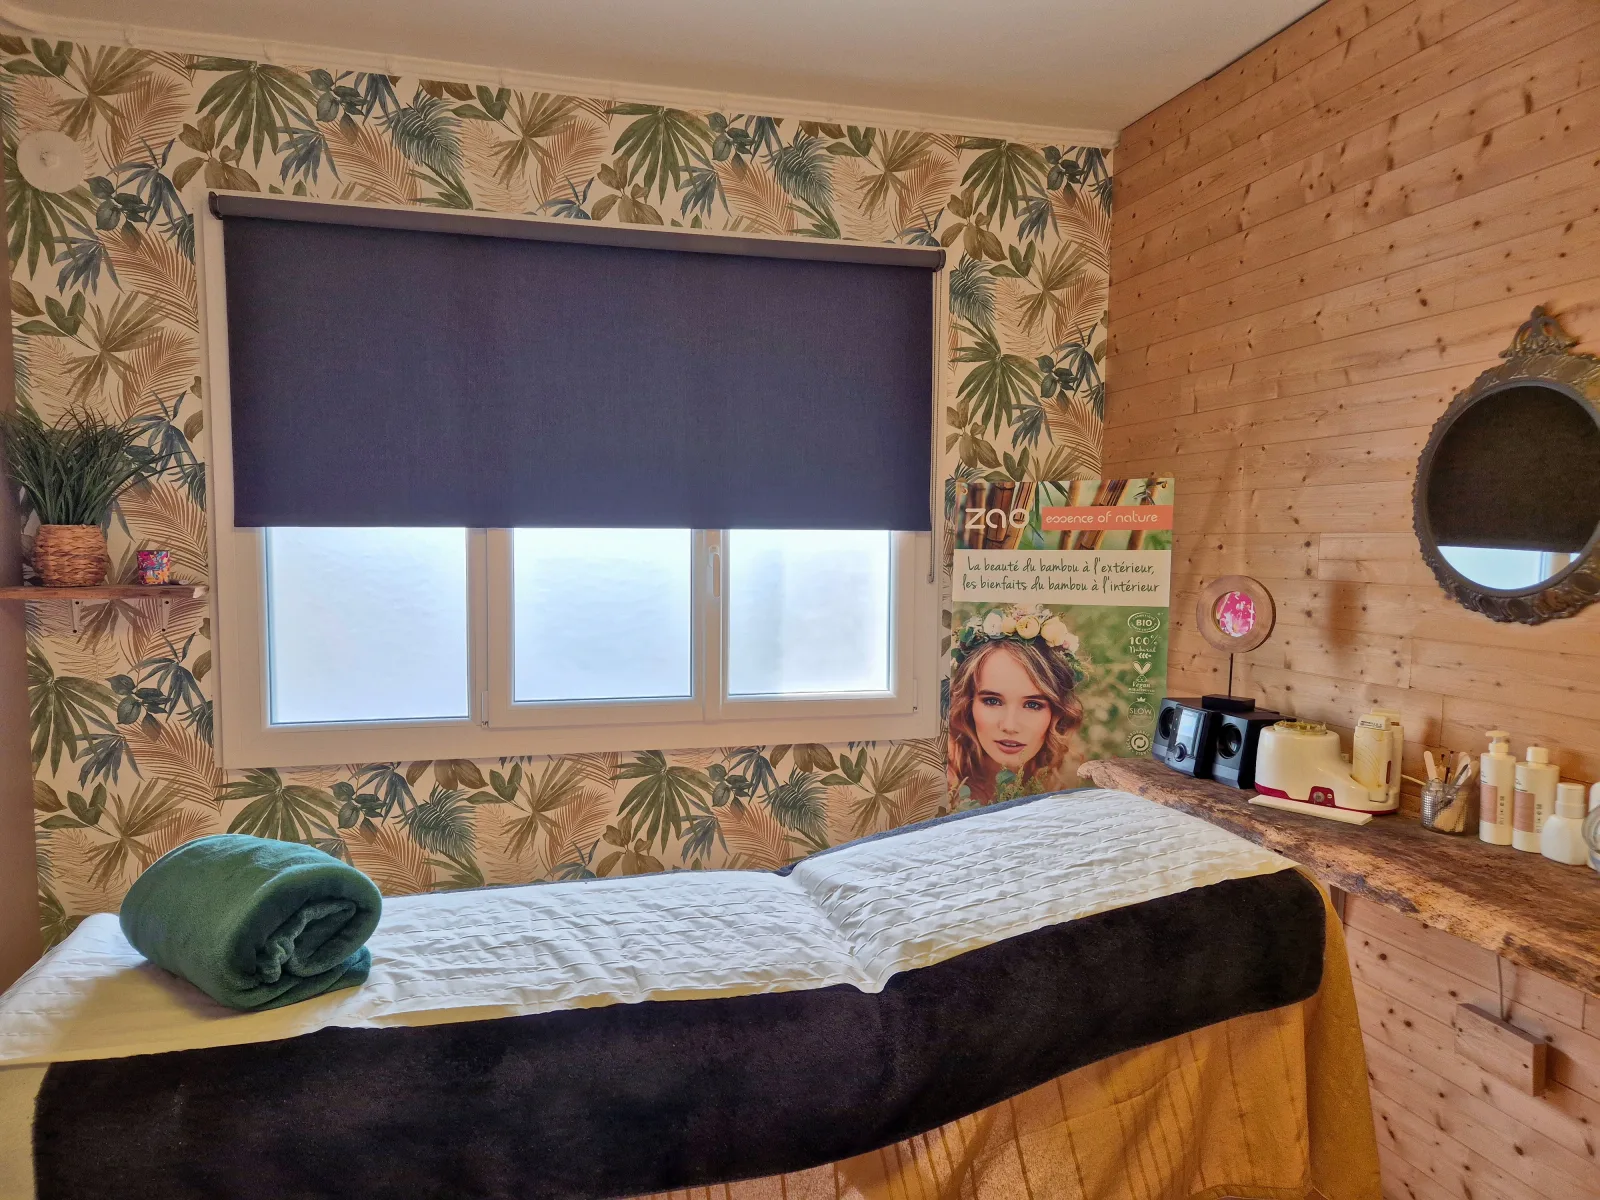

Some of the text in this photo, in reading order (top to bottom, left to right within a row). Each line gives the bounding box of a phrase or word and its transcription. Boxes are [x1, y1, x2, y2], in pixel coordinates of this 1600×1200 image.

[965, 508, 1030, 530] zao
[1046, 510, 1158, 524] essence of nature
[968, 556, 1155, 575] La beauté du bambou à l'extérieur,
[962, 574, 1160, 594] les bienfaits du bambou à l'intérieur
[1129, 635, 1158, 645] 100%
[1132, 681, 1151, 689] Vegan
